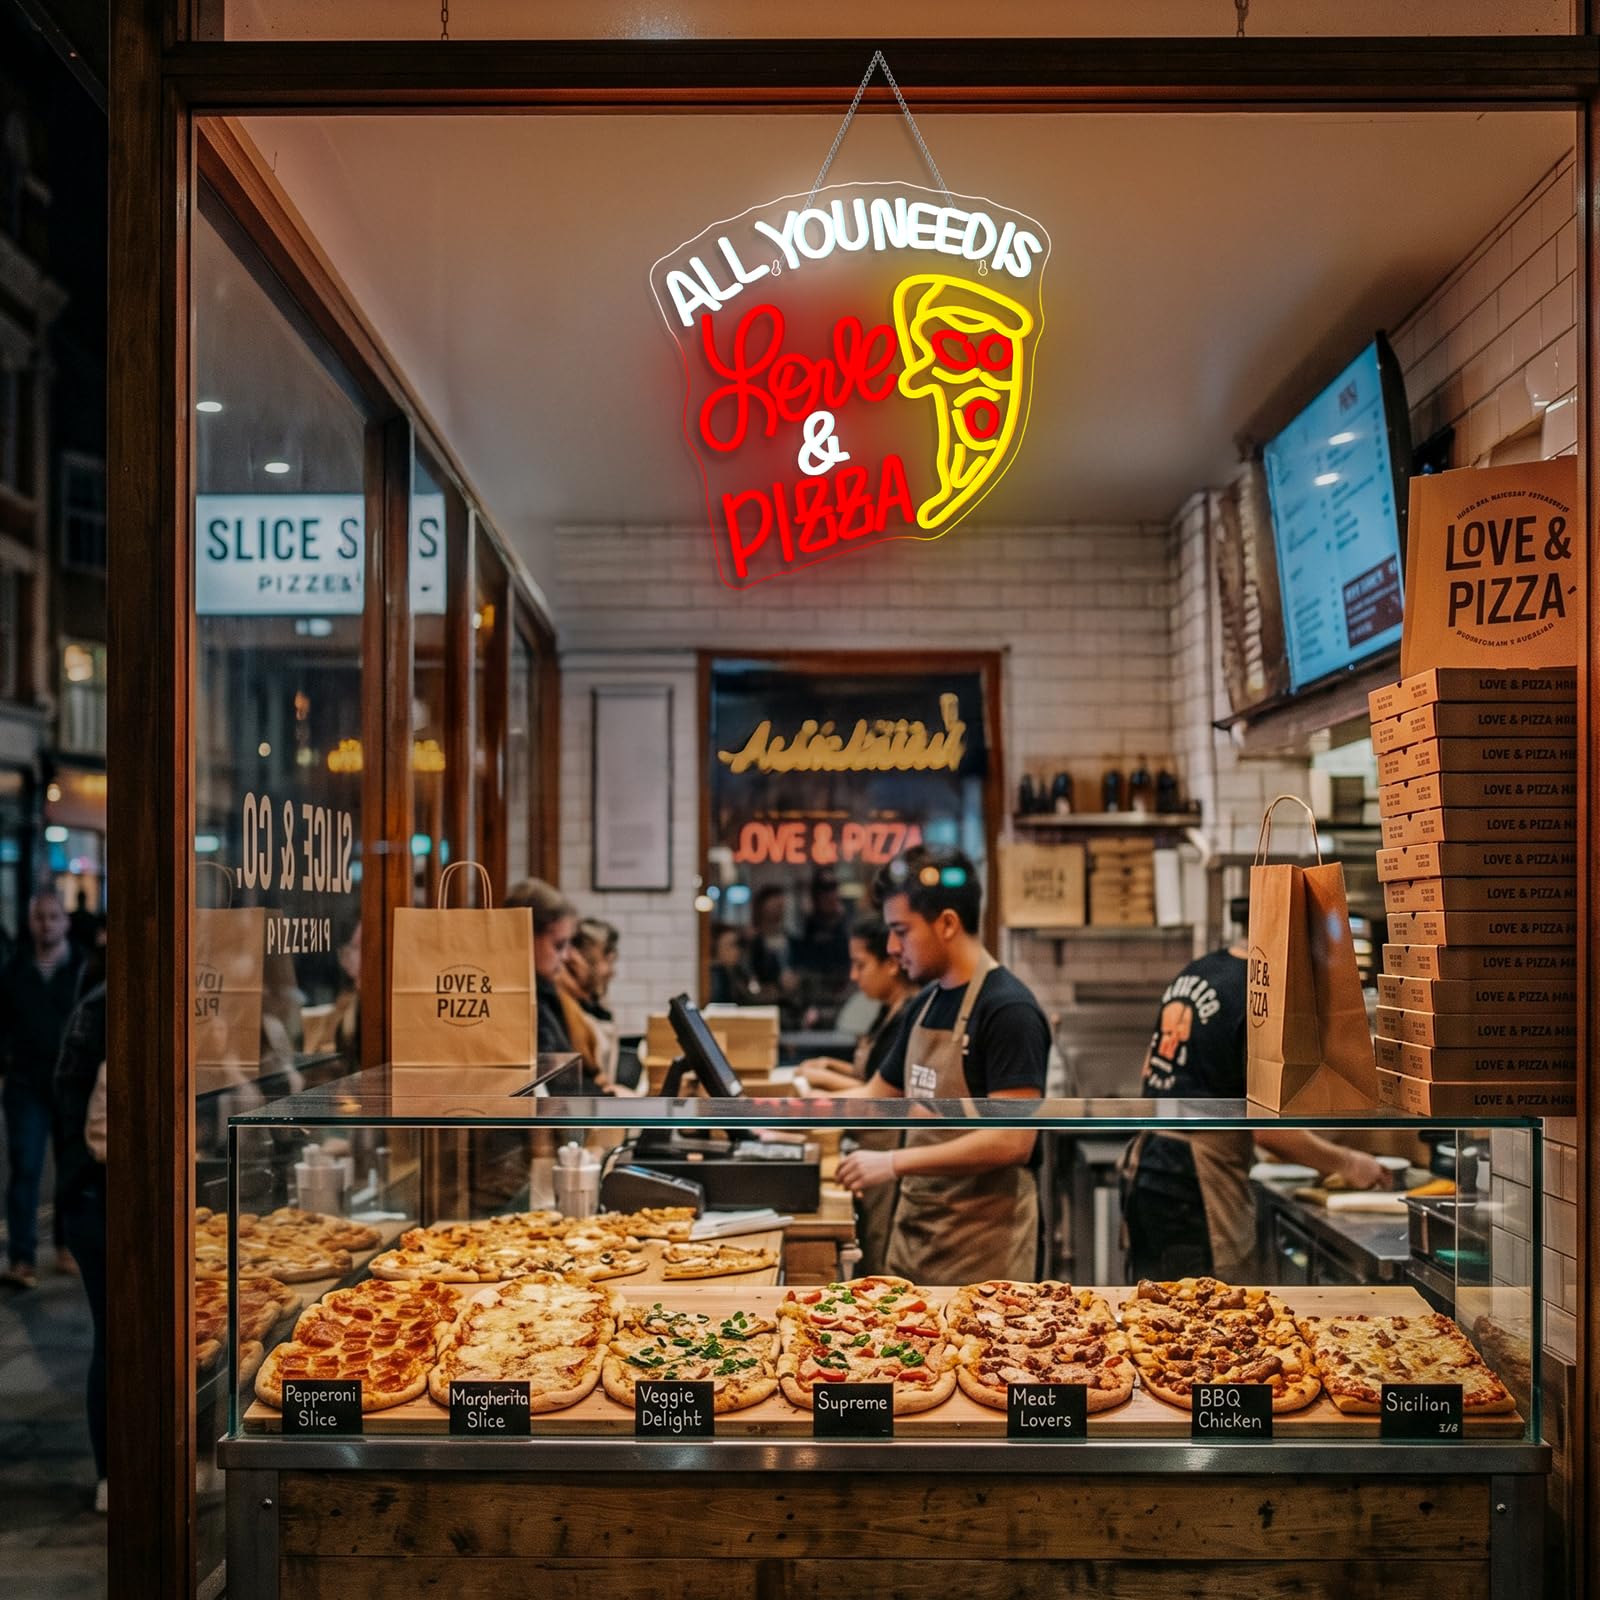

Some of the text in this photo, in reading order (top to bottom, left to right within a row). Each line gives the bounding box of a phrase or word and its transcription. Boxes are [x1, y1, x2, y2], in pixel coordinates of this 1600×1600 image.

[666, 197, 1043, 327] ALL YOU NEED IS
[700, 304, 899, 452] Love
[798, 410, 851, 476] &
[208, 518, 320, 561] SLICE
[1446, 515, 1572, 571] LOVE &
[1448, 572, 1567, 627] PIZZA
[1479, 680, 1506, 690] LOVE
[1511, 680, 1519, 690] &
[1521, 680, 1552, 690] PIZZA
[1479, 715, 1506, 725] LOVE
[1510, 715, 1518, 725] &
[1521, 715, 1552, 725] PIZZA
[1483, 750, 1510, 761] LOVE
[1514, 750, 1522, 761] &
[1525, 750, 1556, 761] PIZZA
[1484, 784, 1512, 796] LOVE
[1515, 784, 1523, 796] &
[1527, 784, 1558, 796] PIZZA
[1487, 819, 1515, 831] LOVE
[1519, 819, 1527, 831] &
[1530, 819, 1560, 831] PIZZA
[1484, 854, 1511, 865] LOVE
[1515, 854, 1523, 865] &
[1527, 854, 1557, 865] PIZZA
[1487, 888, 1515, 900] LOVE
[1519, 888, 1527, 900] &
[1531, 888, 1561, 900] PIZZA
[1489, 923, 1517, 934] LOVE
[1521, 923, 1529, 934] &
[1532, 923, 1563, 934] PIZZA
[1484, 957, 1511, 968] LOVE
[1515, 957, 1522, 968] &
[1526, 957, 1557, 968] PIZZA
[436, 974, 492, 994] LOVE &
[1476, 991, 1504, 1003] LOVE
[1508, 991, 1515, 1003] &
[1519, 991, 1549, 1003] PIZZA
[437, 998, 490, 1018] PIZZA
[1478, 1026, 1506, 1037] LOVE
[1510, 1026, 1517, 1037] &
[1521, 1026, 1551, 1037] PIZZA
[1476, 1060, 1504, 1071] LOVE
[1507, 1060, 1514, 1071] &
[1518, 1060, 1548, 1071] PIZZA
[1475, 1095, 1503, 1106] LOVE
[1507, 1095, 1514, 1106] &
[1518, 1095, 1548, 1106] PIZZA
[285, 1384, 356, 1408] Pepperoni
[452, 1388, 529, 1410] Margherita
[640, 1385, 695, 1409] Veggie
[818, 1391, 888, 1417] Supreme
[1013, 1388, 1056, 1406] Meat
[1200, 1388, 1241, 1408] BBQ
[1386, 1391, 1450, 1414] Sicilian
[298, 1410, 337, 1427] Slice
[467, 1412, 506, 1429] Slice
[642, 1410, 702, 1434] Delight
[1020, 1411, 1072, 1428] Lovers
[1198, 1411, 1262, 1429] Chicken
